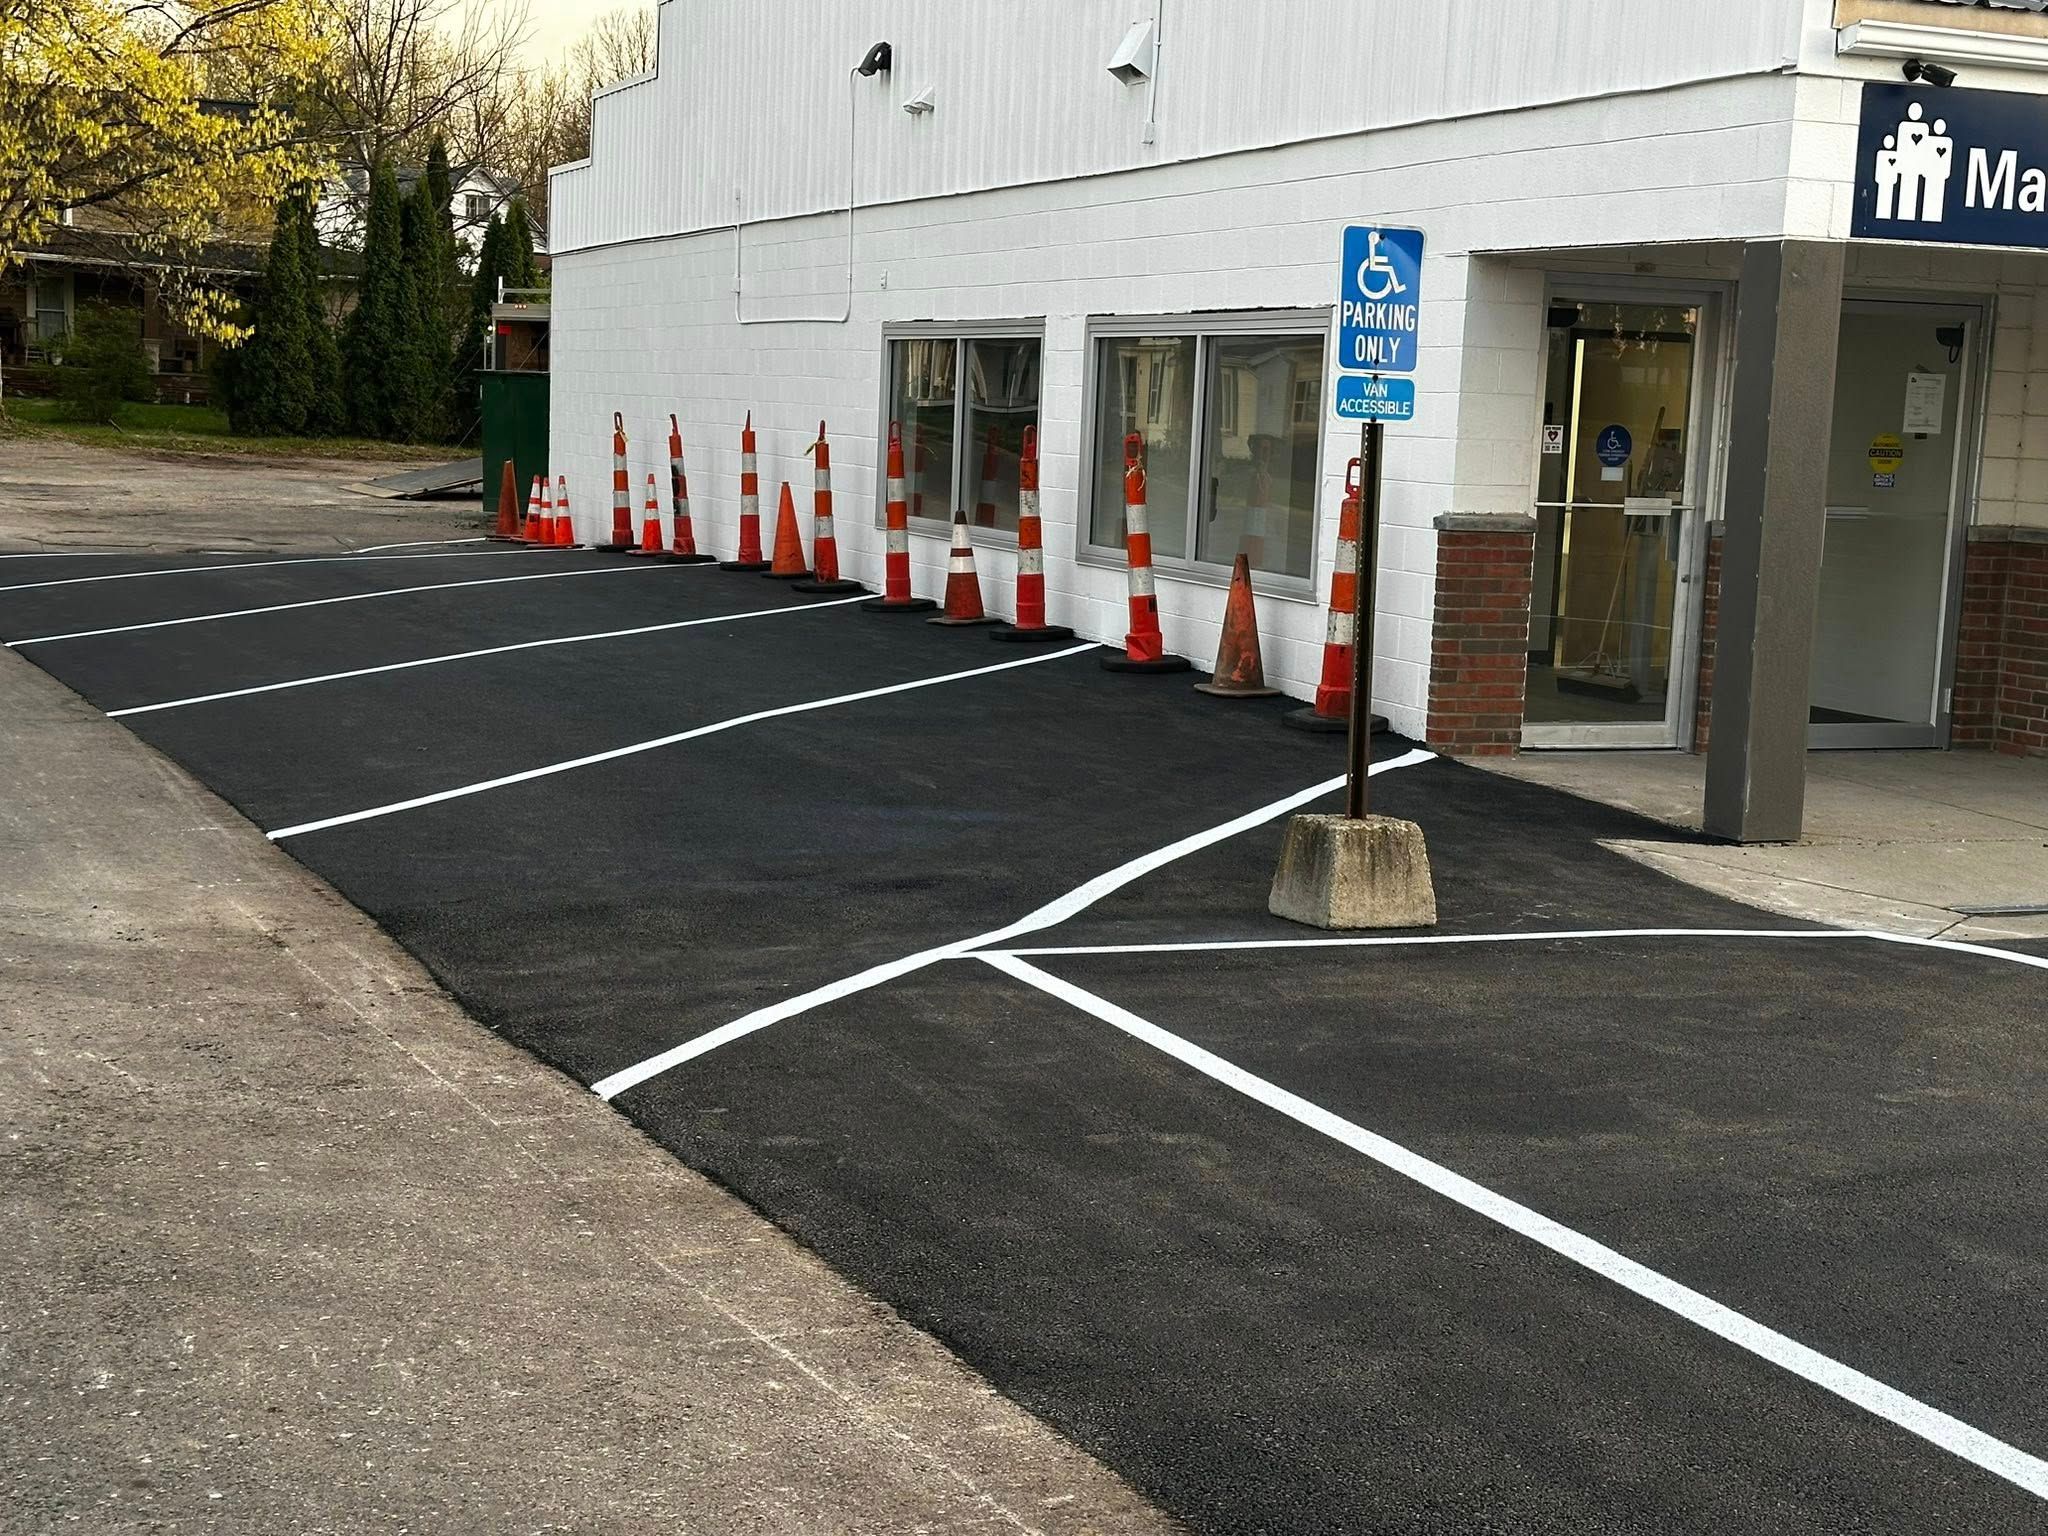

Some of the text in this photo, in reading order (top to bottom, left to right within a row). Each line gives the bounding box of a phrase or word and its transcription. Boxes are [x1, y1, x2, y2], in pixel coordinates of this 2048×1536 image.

[1964, 147, 2046, 213] Ma
[1342, 300, 1416, 331] PARKING
[1355, 334, 1401, 363] ONLY
[1363, 382, 1388, 397] VAN
[1339, 399, 1410, 415] ACCESSIBLE
[1869, 449, 1901, 457] CAUTION
